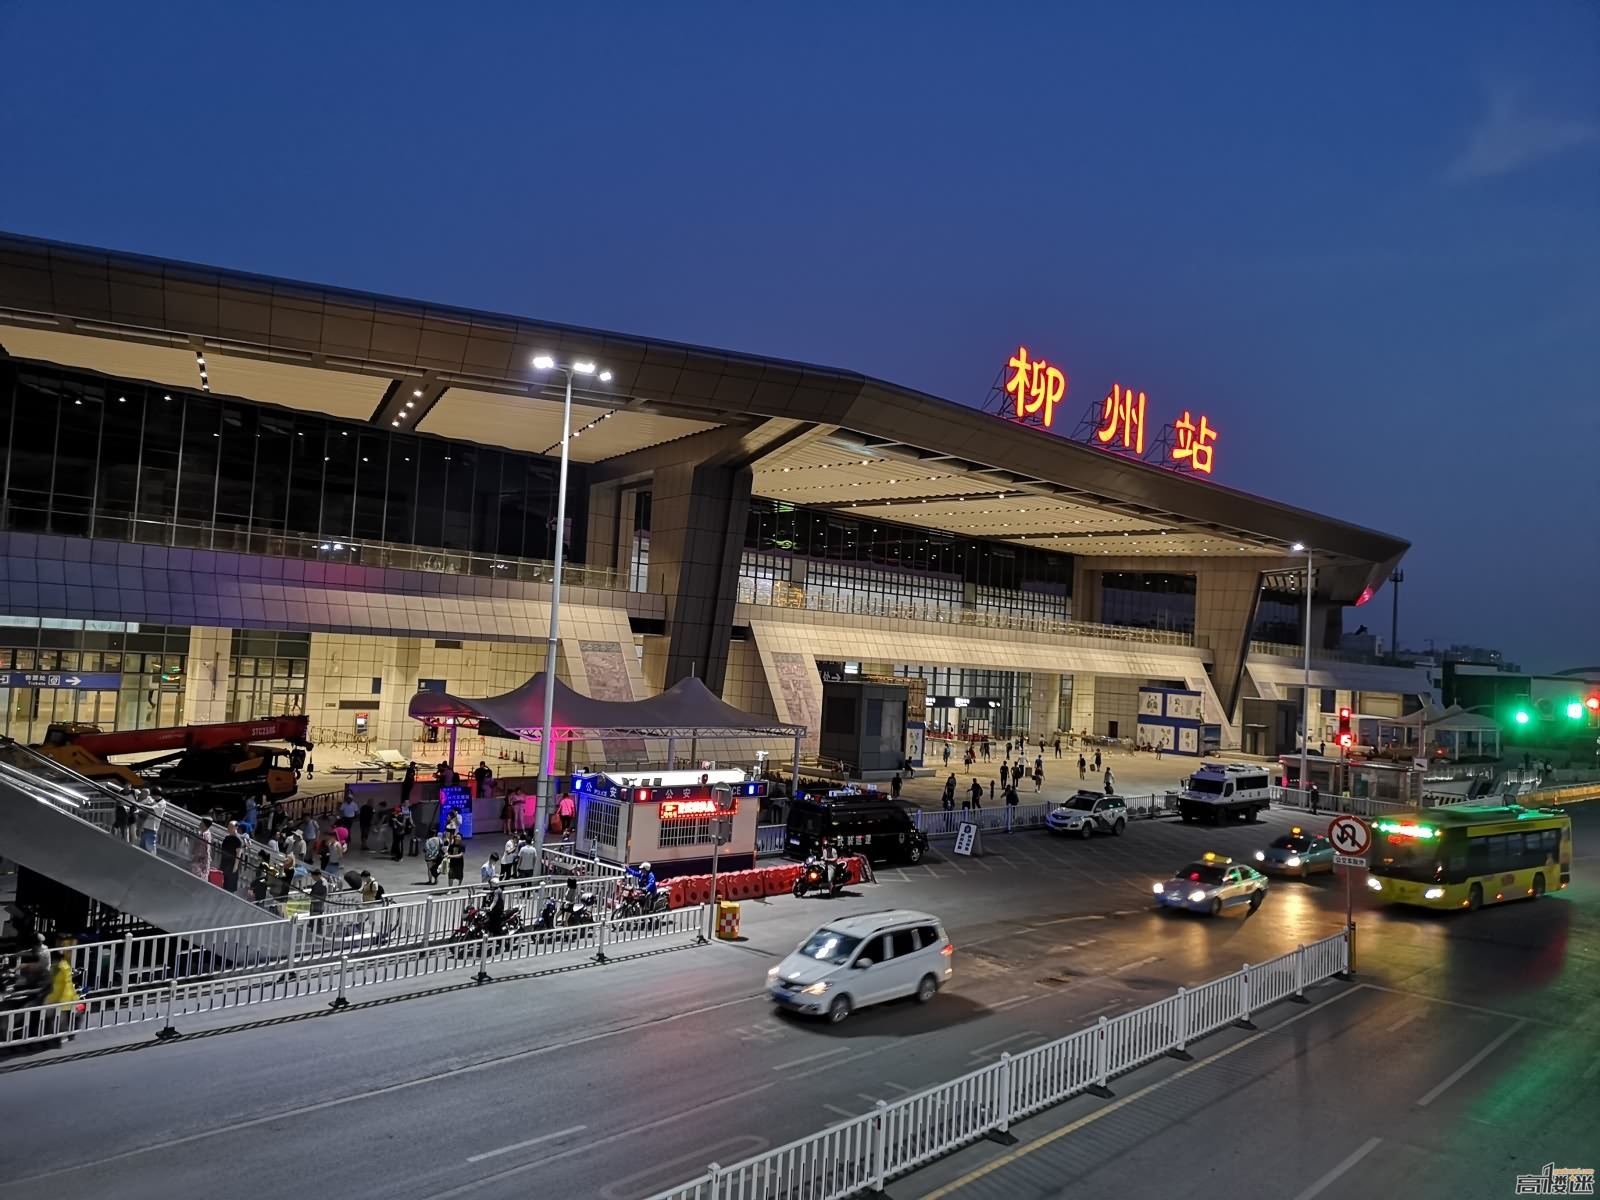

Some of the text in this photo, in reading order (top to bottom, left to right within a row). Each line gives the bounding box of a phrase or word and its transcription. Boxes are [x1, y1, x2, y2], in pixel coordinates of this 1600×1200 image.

[1006, 346, 1217, 473] 柳州站
[25, 674, 46, 682] 售票处
[593, 789, 608, 797] POLICE
[665, 788, 691, 800] 公安
